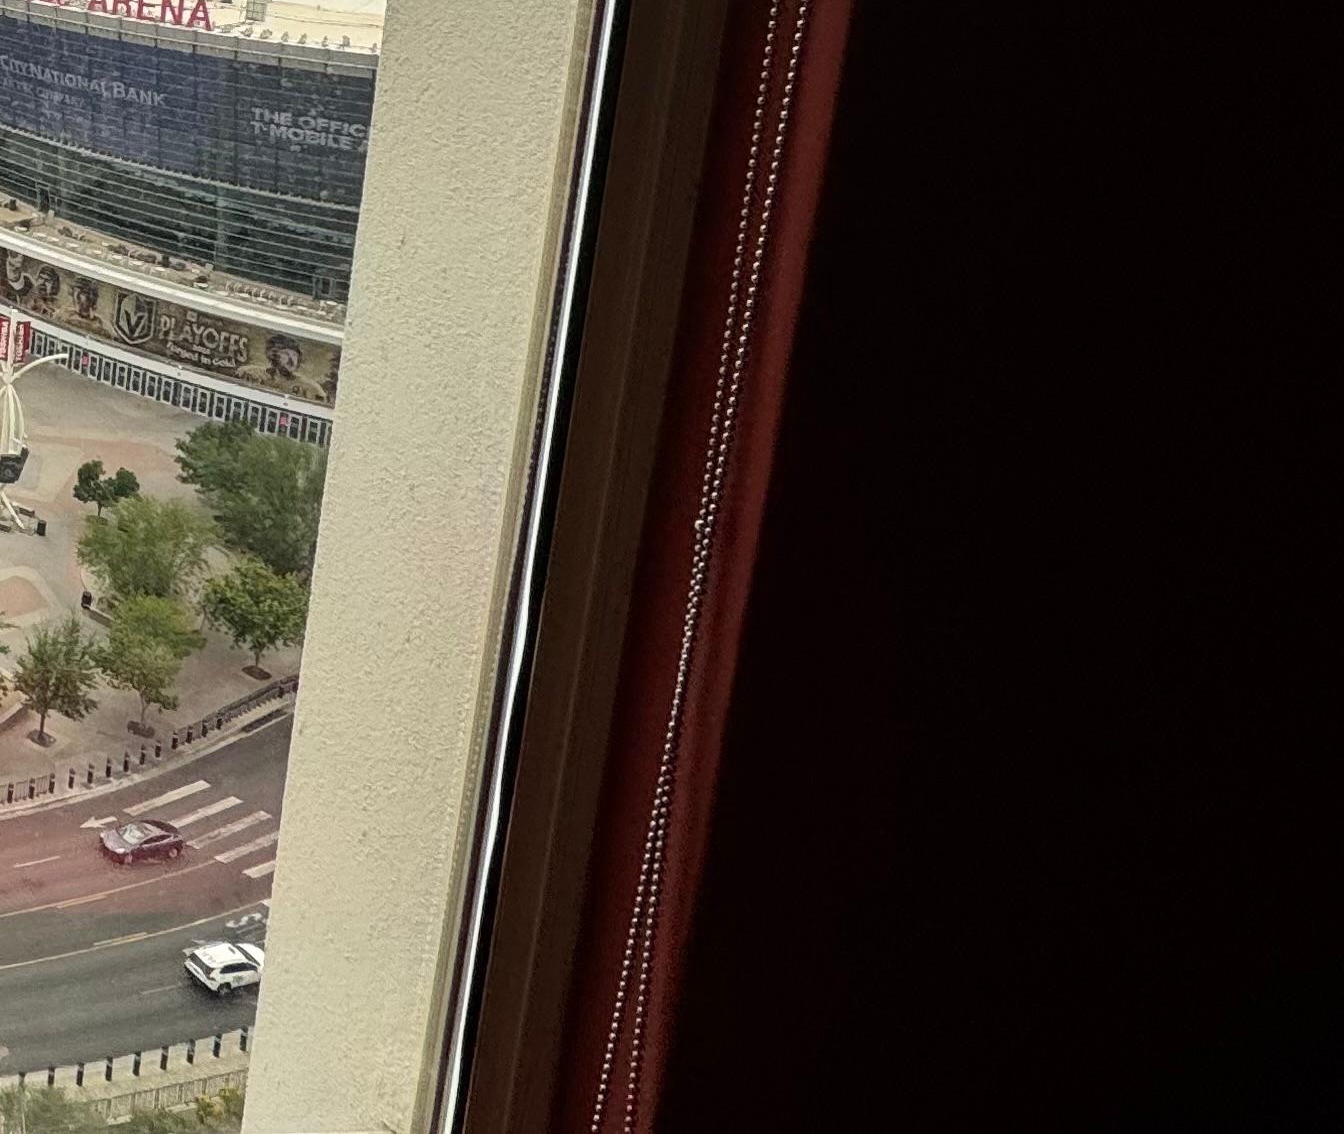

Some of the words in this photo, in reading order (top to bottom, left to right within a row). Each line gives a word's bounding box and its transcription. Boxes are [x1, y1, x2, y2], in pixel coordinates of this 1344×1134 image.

[30, 63, 112, 99] NATIONAL
[112, 81, 166, 106] BANK
[252, 107, 293, 126] THE
[297, 116, 369, 138] OFFIC
[159, 315, 248, 363] PLAYOFFS
